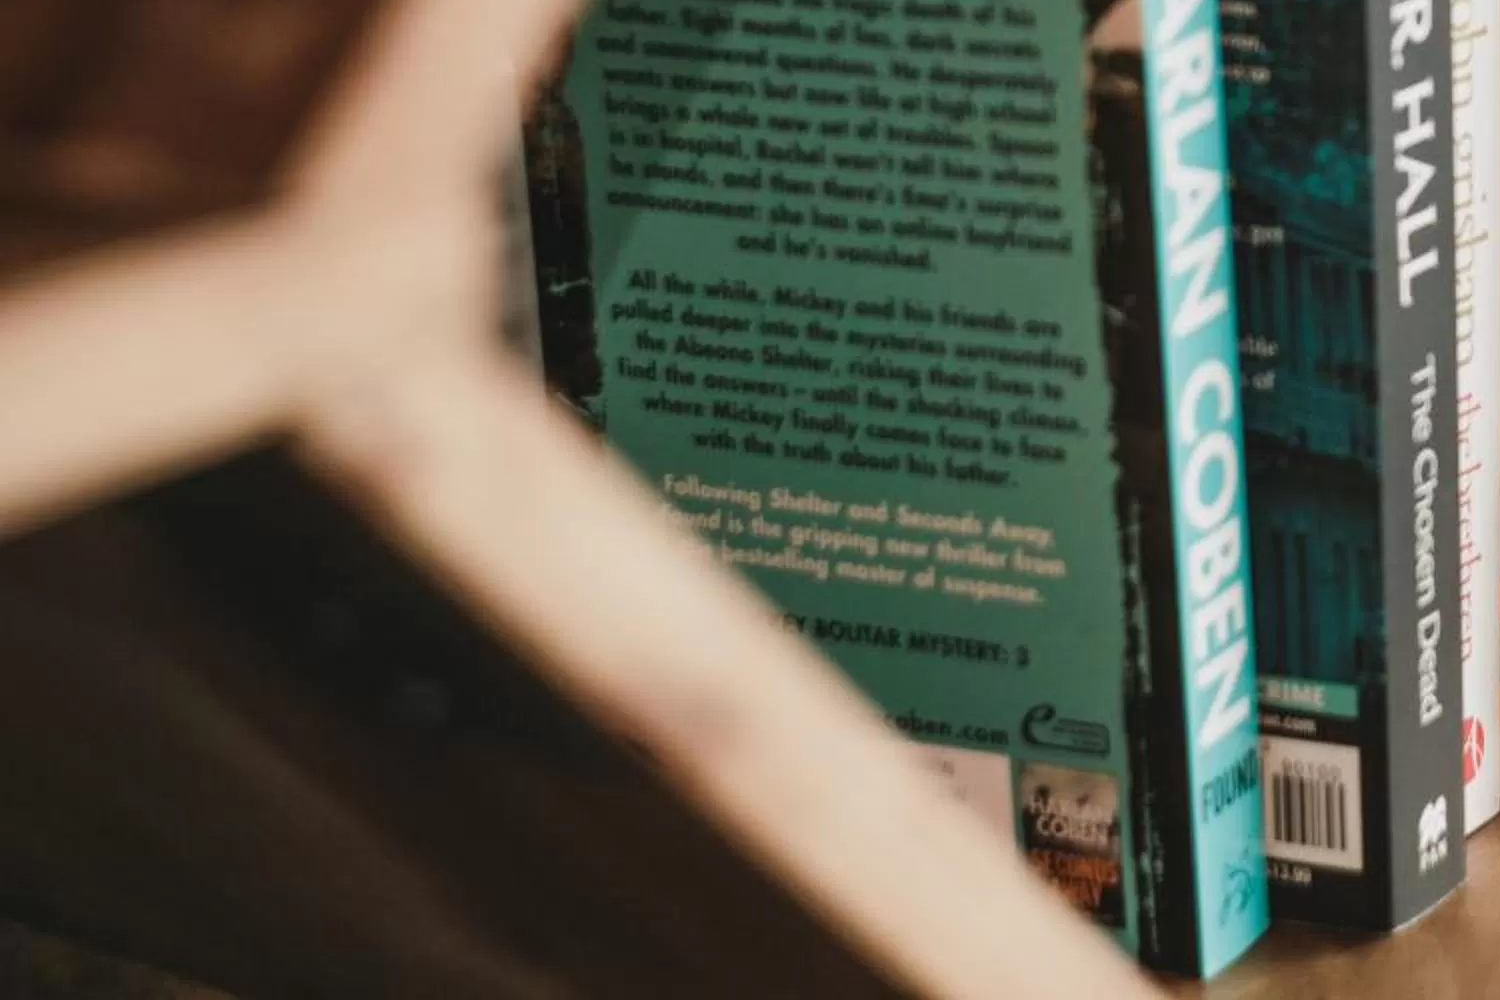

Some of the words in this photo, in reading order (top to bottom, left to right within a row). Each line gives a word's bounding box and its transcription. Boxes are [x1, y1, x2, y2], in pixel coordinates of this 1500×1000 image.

[1392, 77, 1440, 308] HALL
[611, 297, 672, 329] pulled
[680, 305, 750, 338] deeper
[759, 315, 798, 339] into
[807, 320, 838, 343] the
[628, 269, 656, 292] All
[664, 273, 695, 297] the
[703, 277, 765, 310] while,
[775, 285, 845, 319] Mickey
[855, 294, 894, 319] and
[903, 300, 933, 324] his
[939, 304, 1016, 333] friends
[1022, 319, 1062, 338] are
[617, 358, 656, 381] find
[664, 363, 694, 385] the
[703, 374, 787, 397] answers
[811, 381, 857, 405] until
[866, 388, 897, 410] the
[907, 393, 1000, 427] shocking
[636, 331, 666, 353] the
[674, 336, 752, 363] Abeona
[761, 346, 839, 378] Shelter,
[848, 356, 921, 388] risking
[928, 366, 976, 389] their
[985, 372, 1033, 396] lives
[1043, 379, 1062, 400] to
[1410, 352, 1438, 442] The
[642, 392, 703, 417] where
[713, 400, 783, 431] Mickey
[792, 410, 857, 440] finally
[866, 424, 929, 444] comes
[936, 428, 982, 451] face
[991, 434, 1012, 454] to
[1019, 438, 1065, 461] face
[662, 473, 760, 515] Following
[770, 486, 841, 518] Shelter
[849, 496, 887, 524] and
[896, 502, 982, 535] Seconds
[988, 513, 1054, 551] Away,
[727, 512, 743, 537] is
[751, 515, 781, 542] the
[790, 520, 878, 560] gripping
[886, 539, 928, 560] new
[936, 539, 1008, 571] thriller
[1012, 549, 1066, 578] from
[1411, 446, 1440, 609] Chosen
[835, 558, 906, 588] master
[913, 568, 934, 591] of
[943, 578, 1046, 611] suspense.
[1177, 359, 1250, 748] COBEN
[810, 618, 901, 647] BOLITAR
[907, 630, 1008, 662] MYSTERY:
[1016, 644, 1029, 666] 3
[1416, 611, 1444, 728] Dead
[1203, 748, 1257, 824] FOUND
